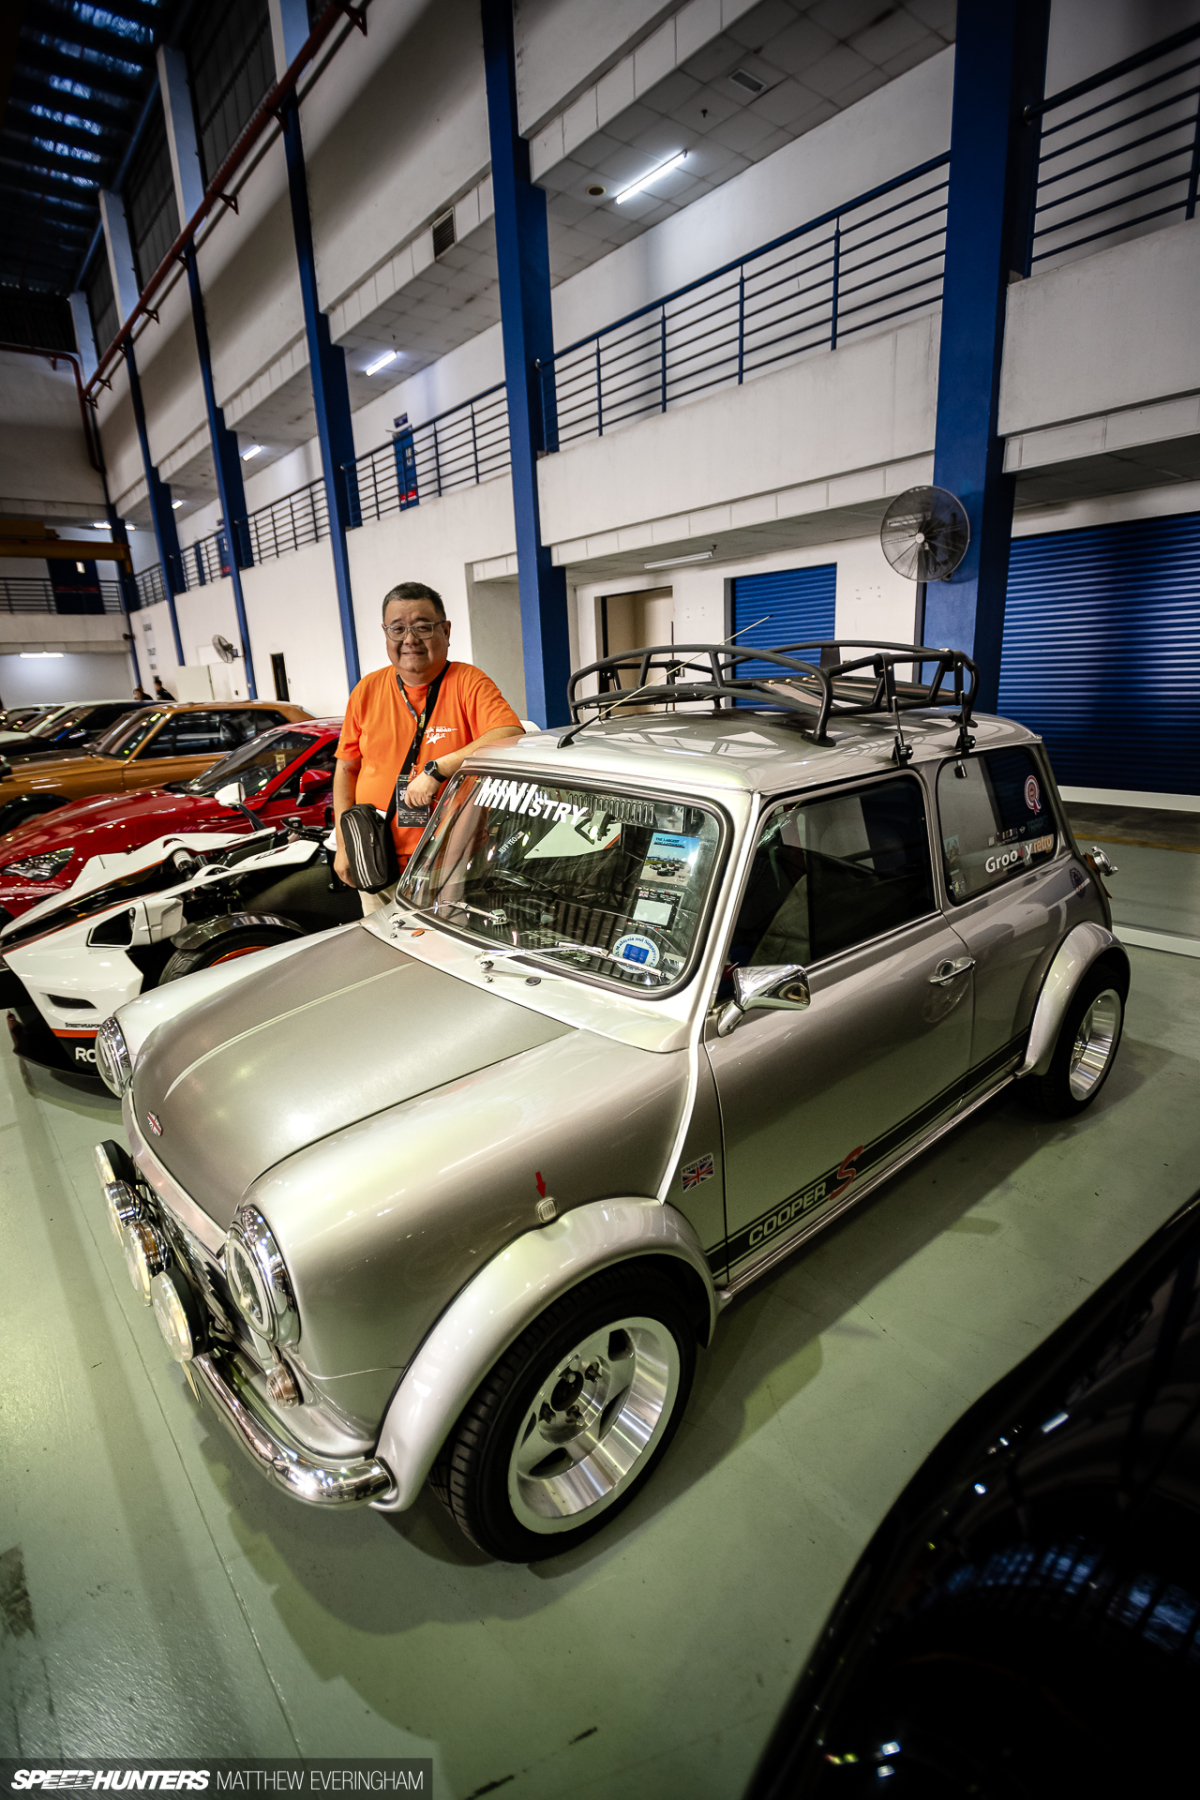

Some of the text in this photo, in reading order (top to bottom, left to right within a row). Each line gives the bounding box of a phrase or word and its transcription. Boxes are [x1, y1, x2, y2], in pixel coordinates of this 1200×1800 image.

[474, 778, 589, 826] MINISTRY
[749, 1145, 864, 1246] COOPER S
